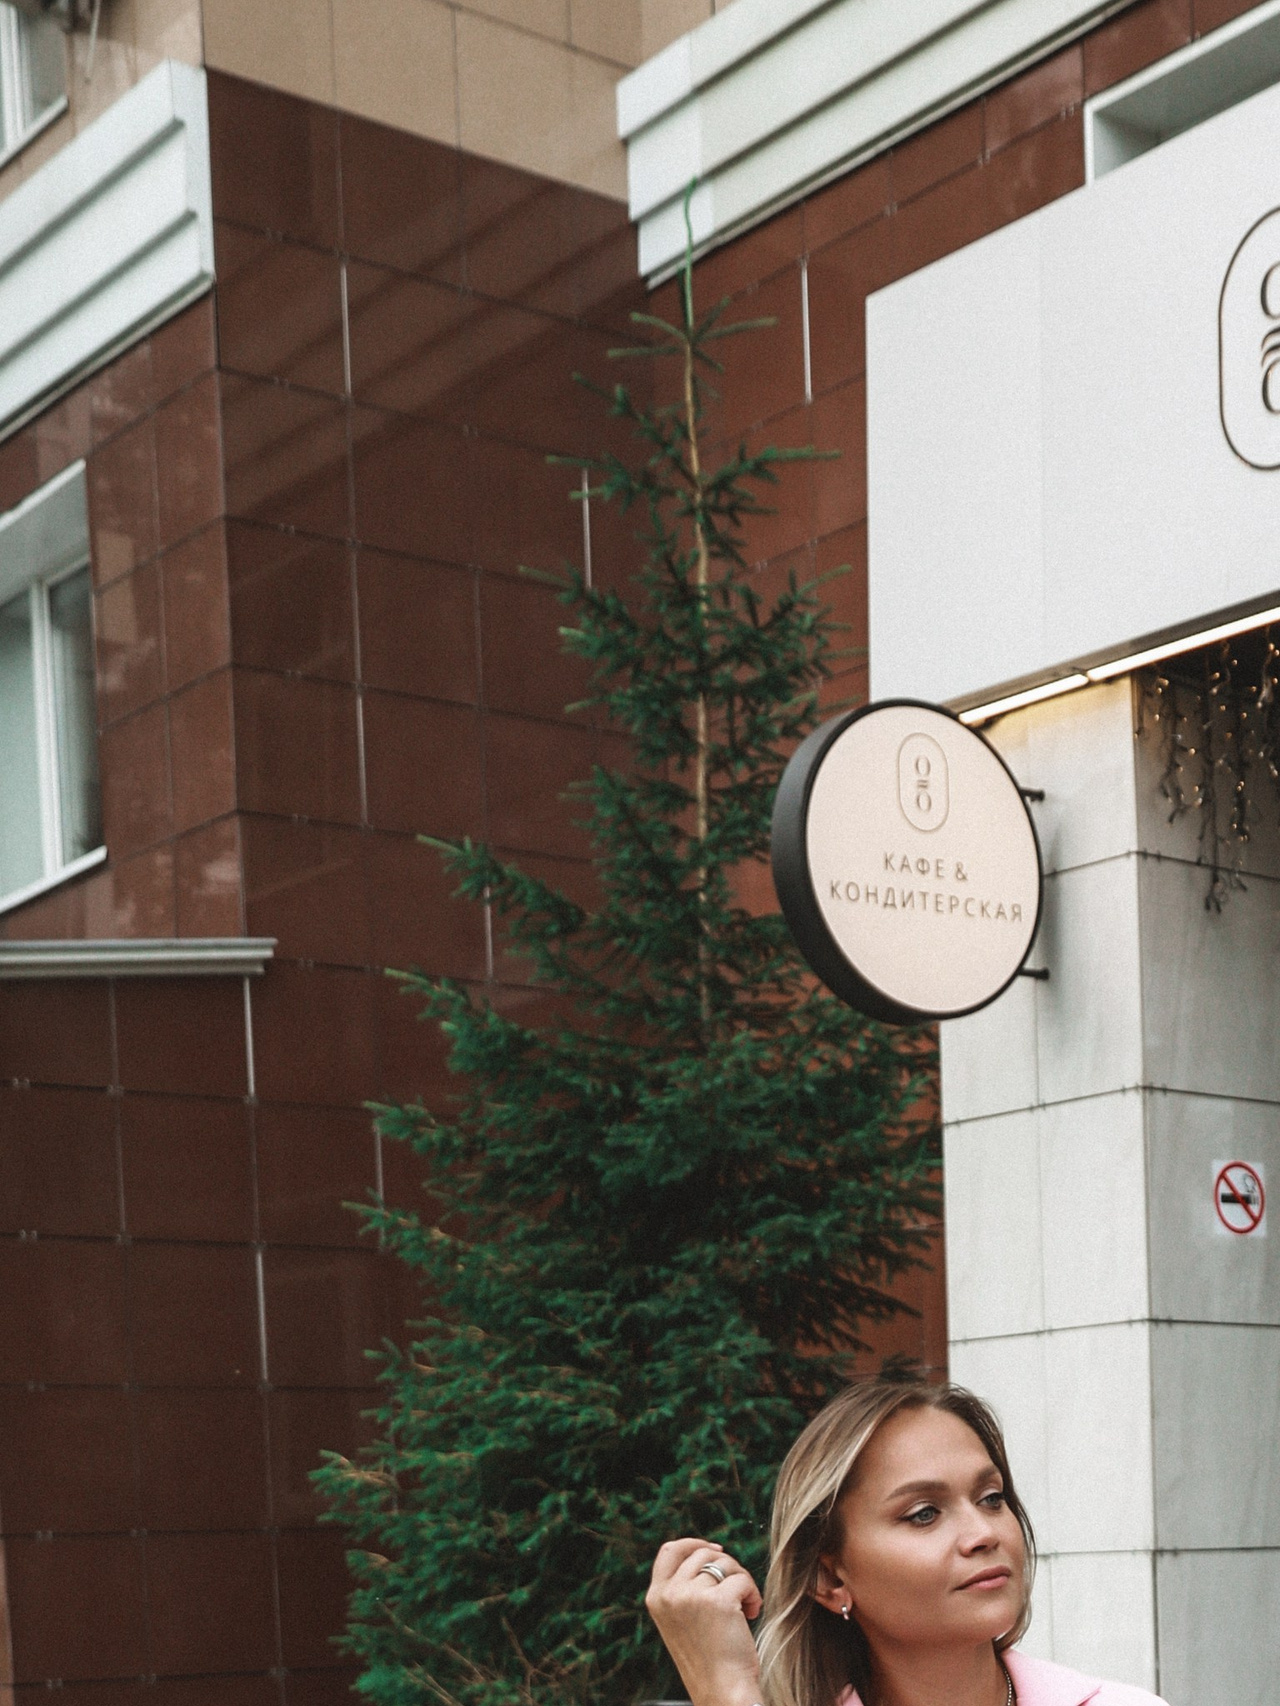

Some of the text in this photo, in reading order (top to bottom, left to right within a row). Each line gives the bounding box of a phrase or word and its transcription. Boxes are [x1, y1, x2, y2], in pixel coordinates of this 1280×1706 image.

[883, 852, 969, 882] КАФЕ &
[829, 880, 1023, 922] КОНДИТЕРСКАЯ
